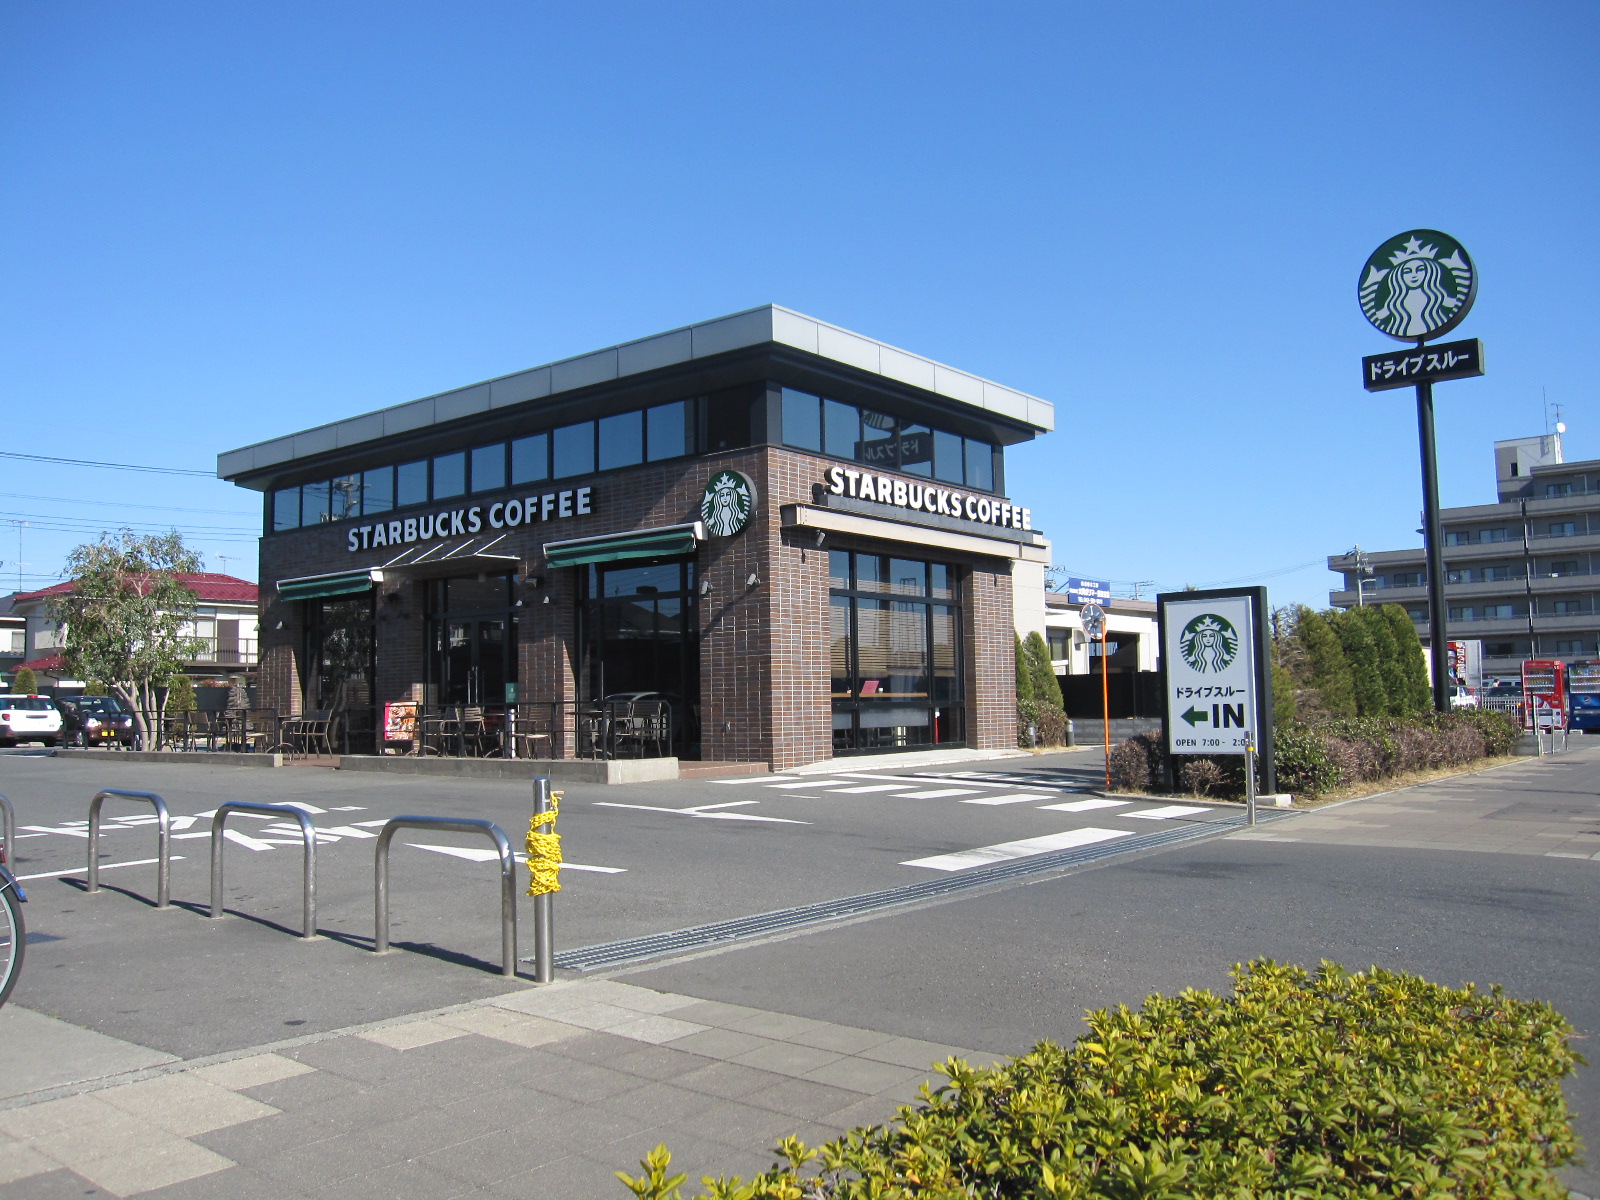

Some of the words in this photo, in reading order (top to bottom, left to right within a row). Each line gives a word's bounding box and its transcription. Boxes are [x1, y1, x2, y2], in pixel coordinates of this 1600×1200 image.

[1371, 351, 1469, 380] ドライブスルー
[830, 467, 962, 517] STARBUCKS
[965, 496, 1032, 530] COFFEE
[348, 506, 481, 551] STARBUCKS
[489, 487, 591, 528] COFFEE
[1176, 686, 1245, 698] ドライブスルー
[1212, 703, 1245, 728] IN
[1175, 739, 1197, 747] OPEN
[1202, 739, 1220, 747] 7:00
[1232, 739, 1246, 747] 2:0
